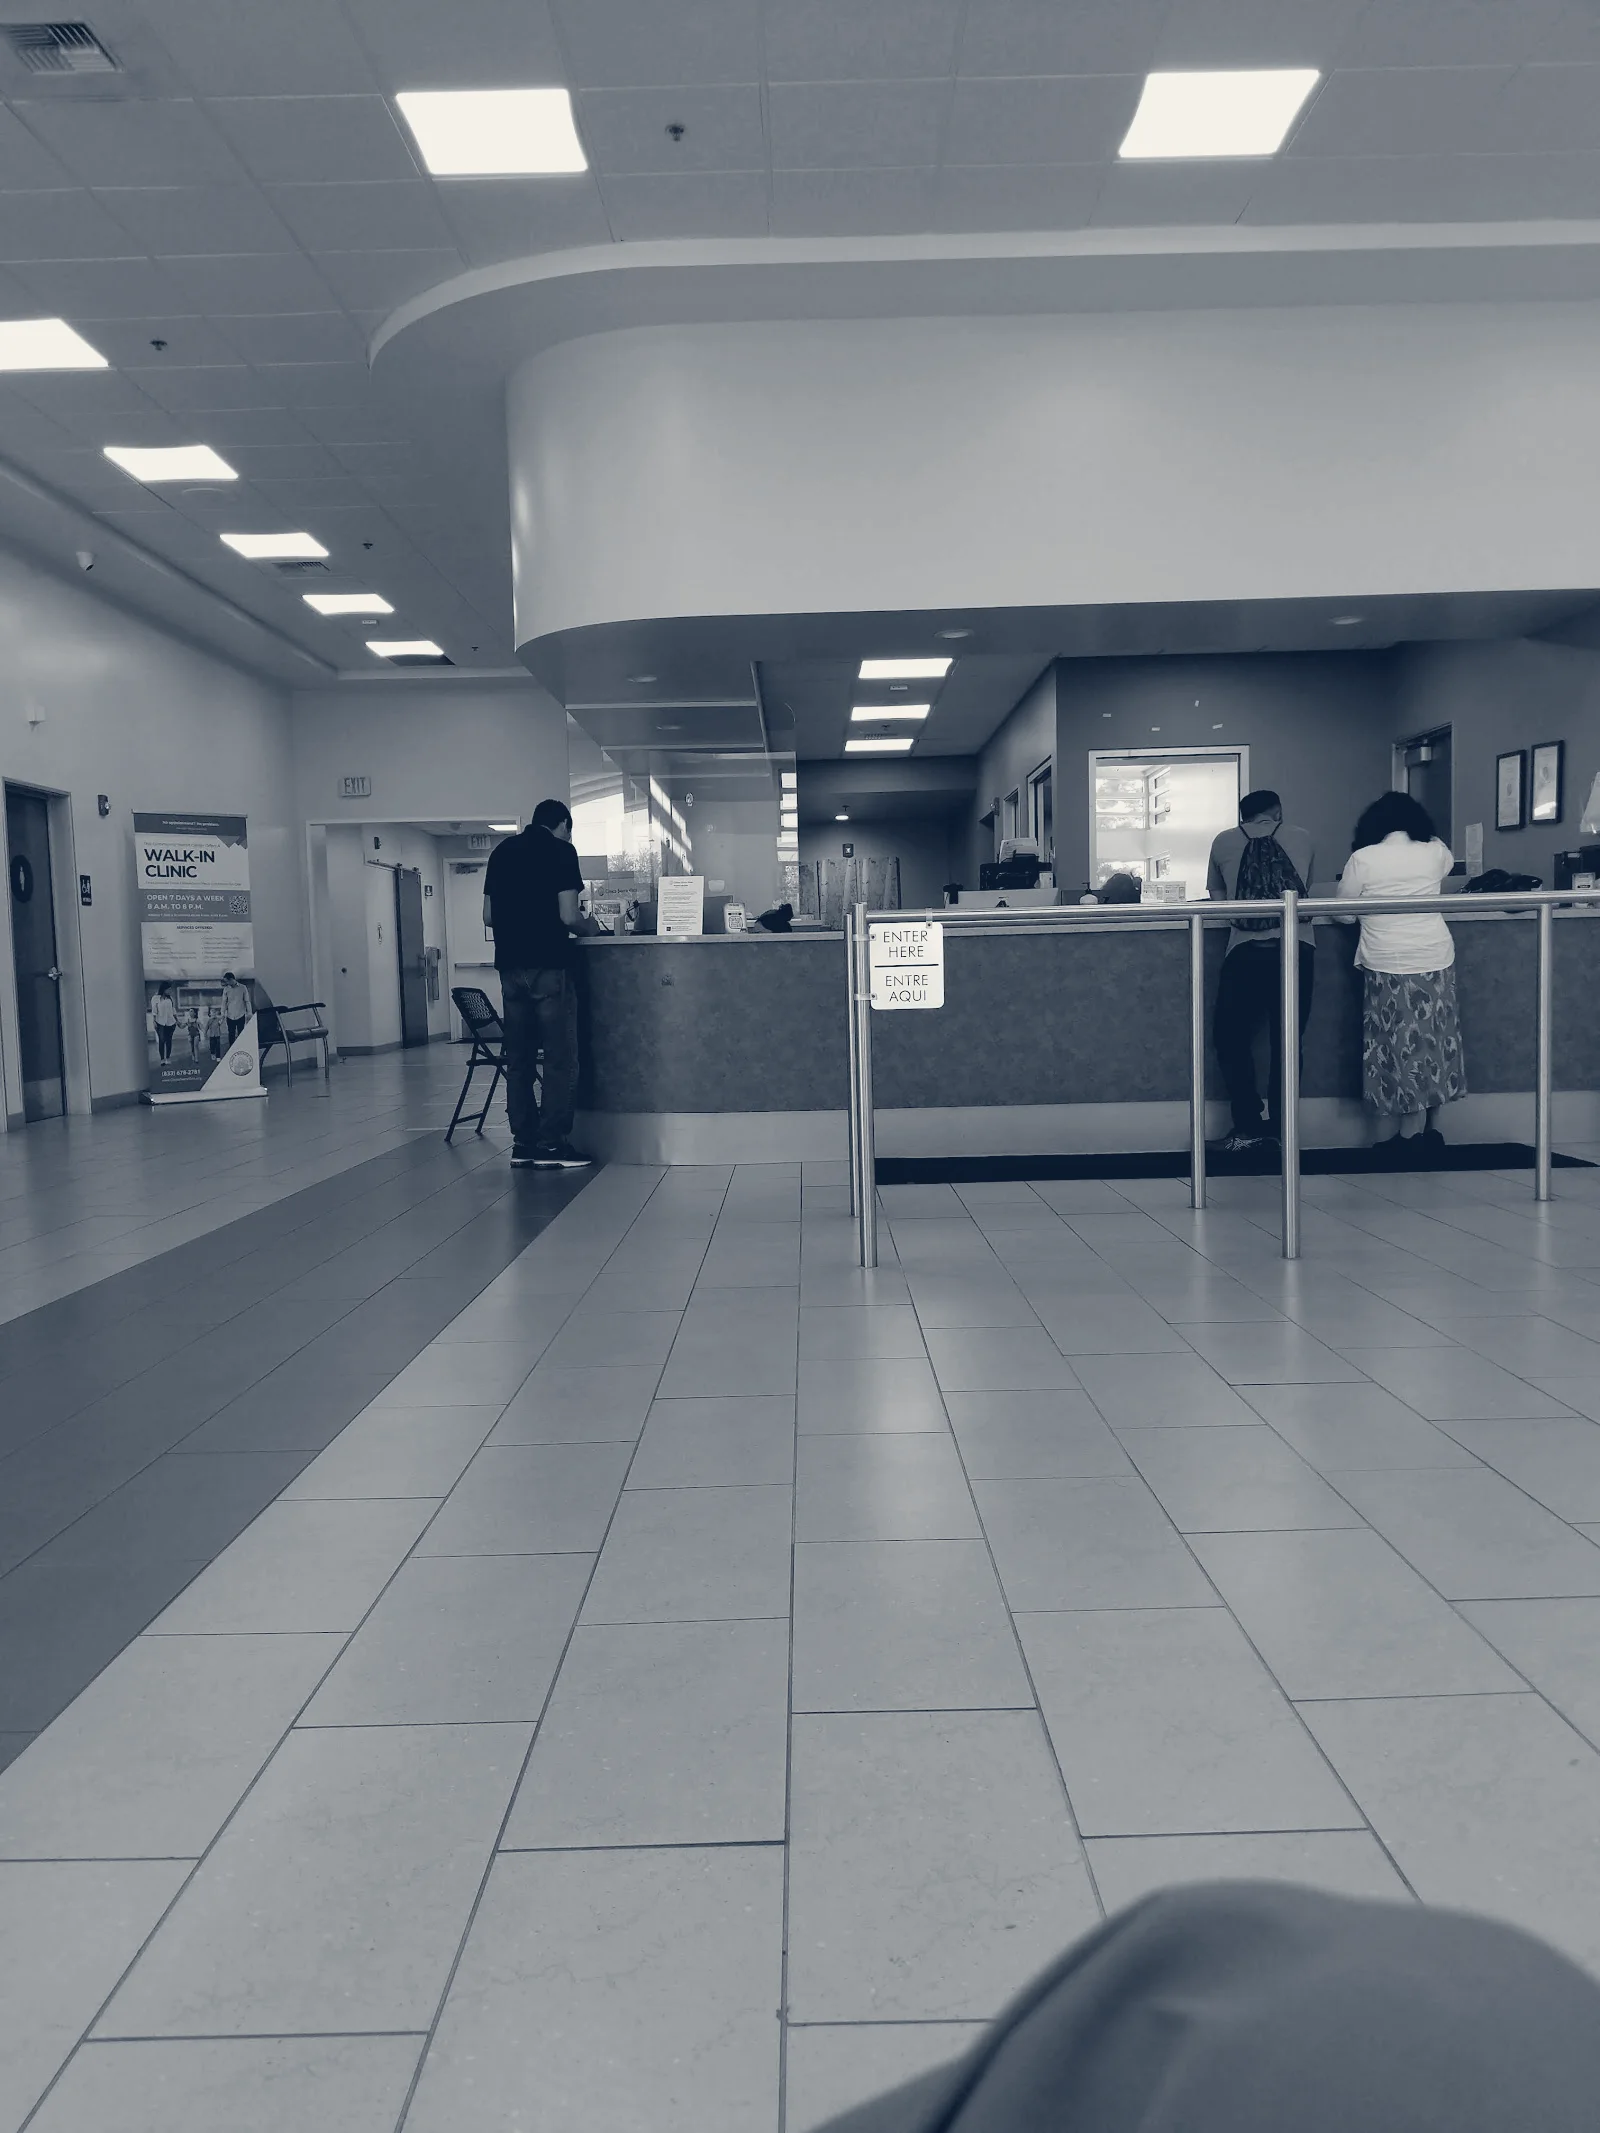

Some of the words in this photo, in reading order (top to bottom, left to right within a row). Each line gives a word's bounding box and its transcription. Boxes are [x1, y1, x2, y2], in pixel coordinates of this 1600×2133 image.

[343, 776, 366, 794] EXIT
[471, 835, 488, 848] EXIT
[144, 848, 215, 863] WALK-IN
[145, 864, 198, 878] CLINIC
[883, 930, 928, 943] ENTER
[888, 945, 924, 958] HERE
[885, 974, 929, 987] ENTRE
[889, 989, 926, 1003] AQUI
